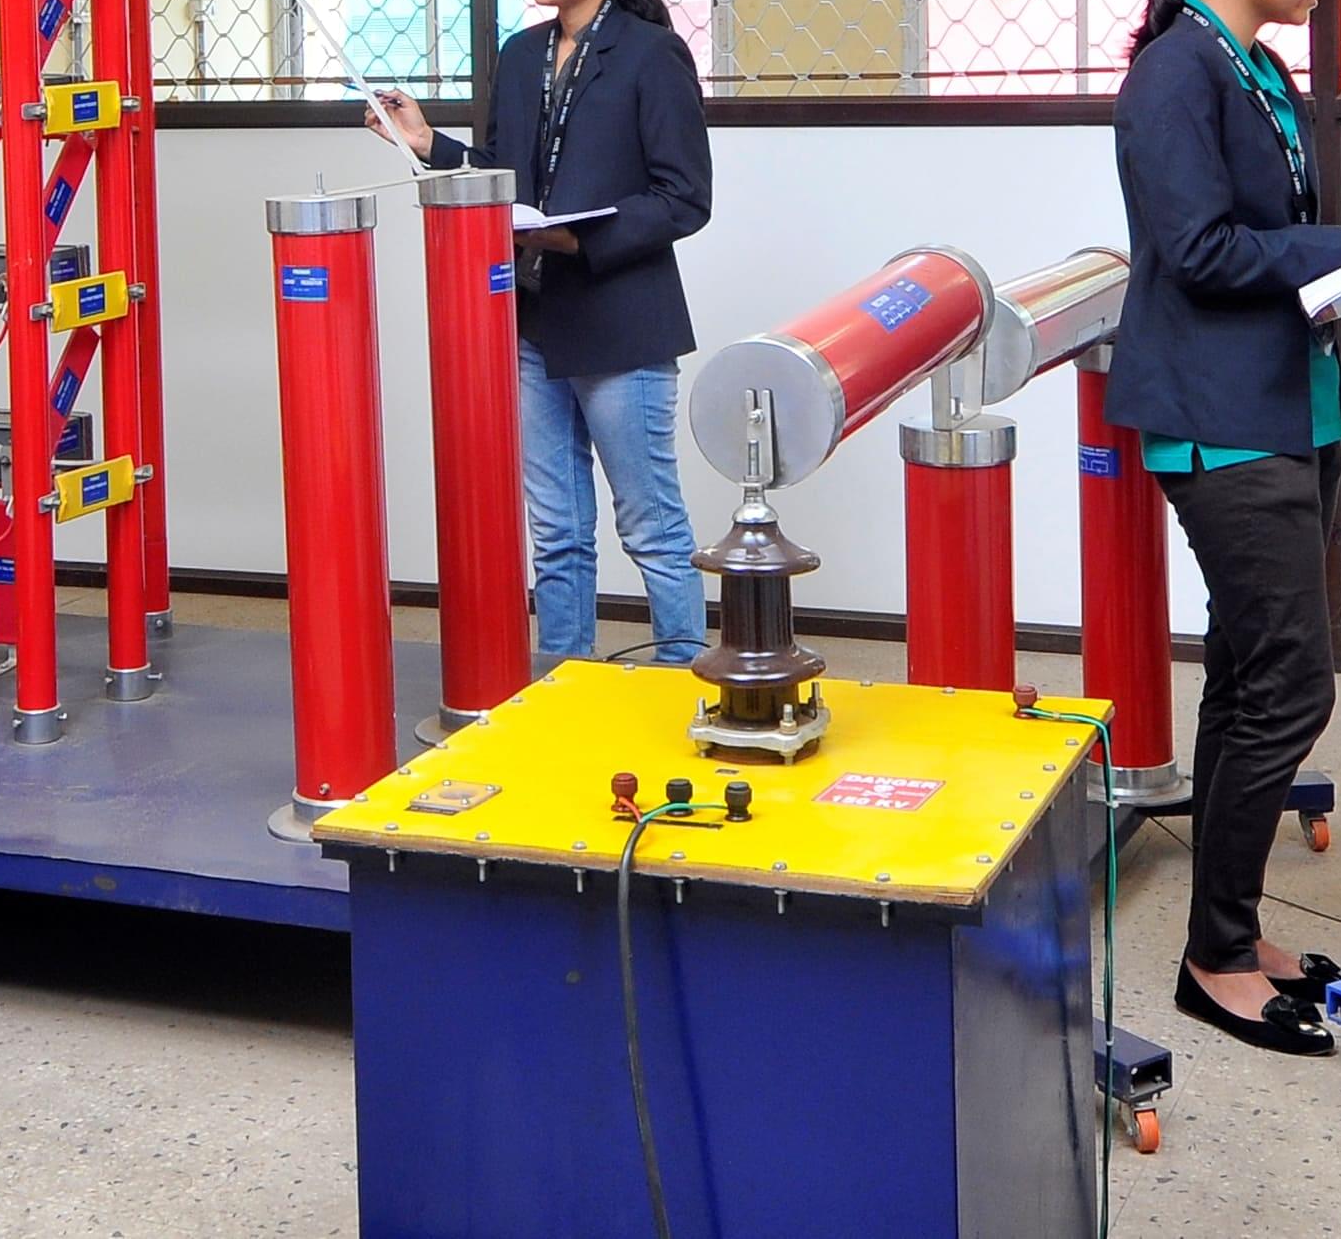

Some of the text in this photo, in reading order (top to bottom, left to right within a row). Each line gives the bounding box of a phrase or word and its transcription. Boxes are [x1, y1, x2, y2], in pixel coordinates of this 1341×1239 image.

[844, 774, 937, 789] DANGER
[832, 795, 910, 809] 150 KV
